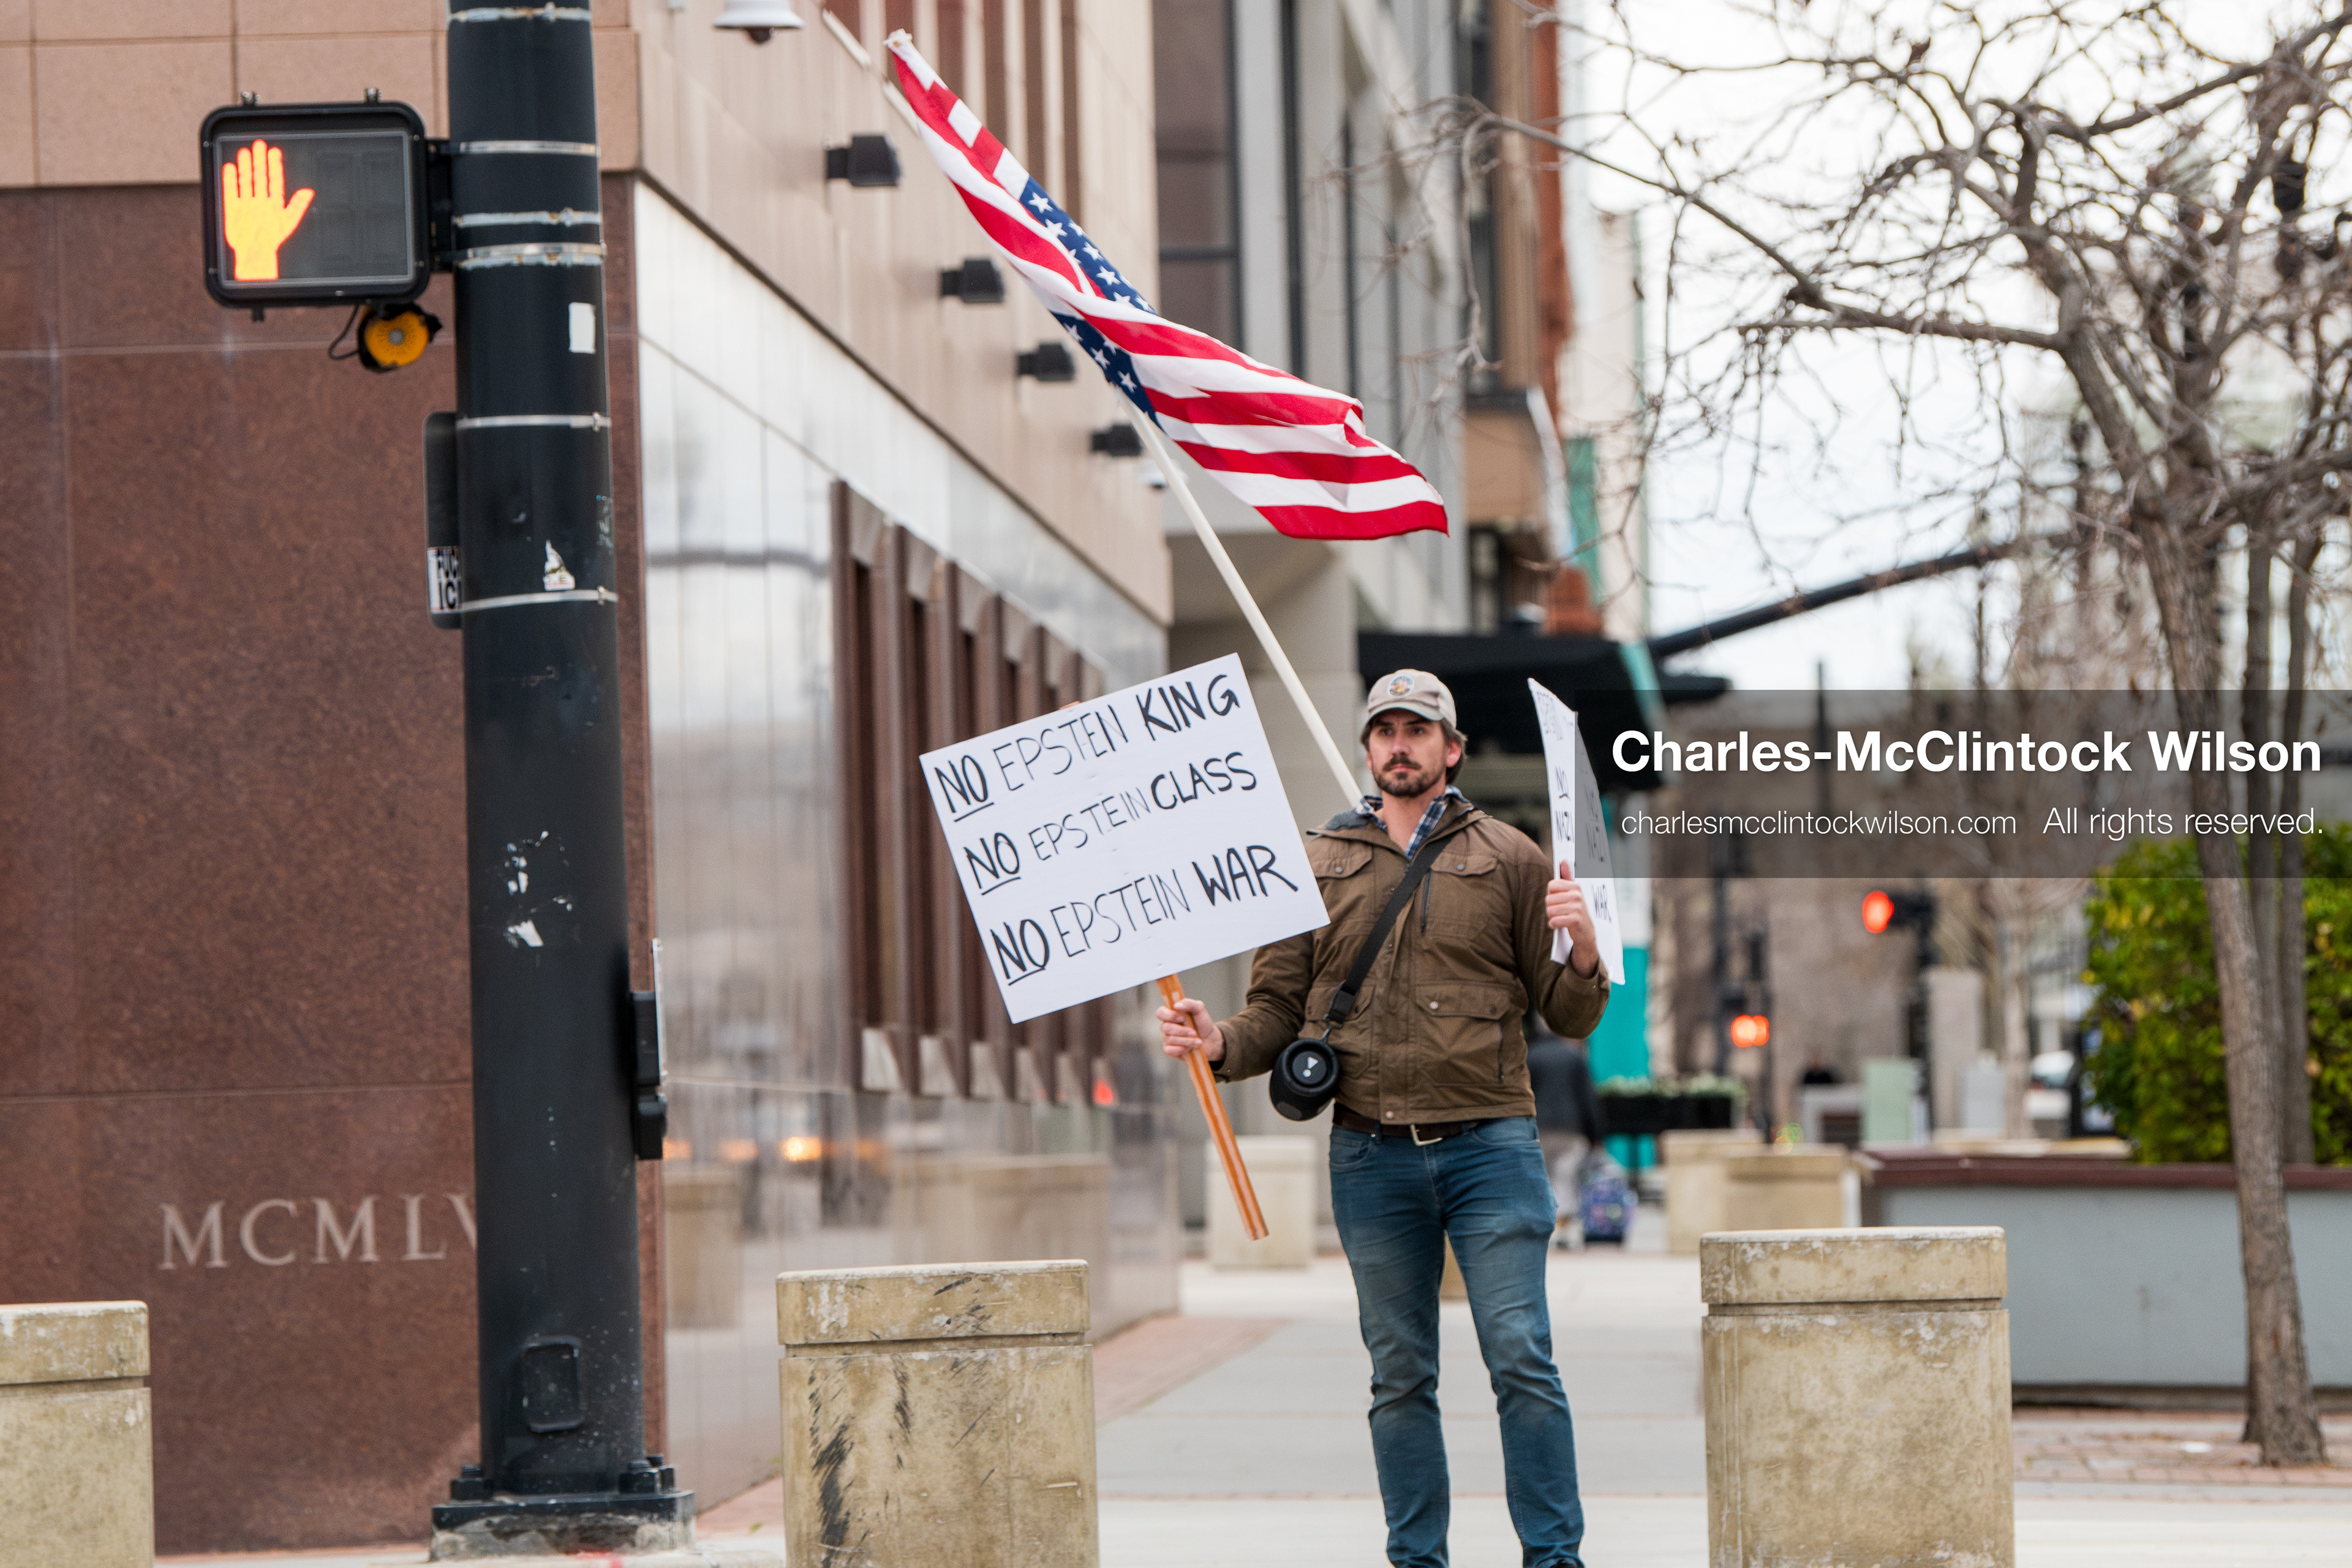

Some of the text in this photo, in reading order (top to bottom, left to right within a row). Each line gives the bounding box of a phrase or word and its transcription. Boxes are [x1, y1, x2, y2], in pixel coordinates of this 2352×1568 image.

[934, 755, 989, 813] NO
[1136, 674, 1241, 741] KING
[963, 752, 1257, 889] NO EPSTEIN CLASS
[990, 844, 1299, 979] NO EPSTEIN WAR
